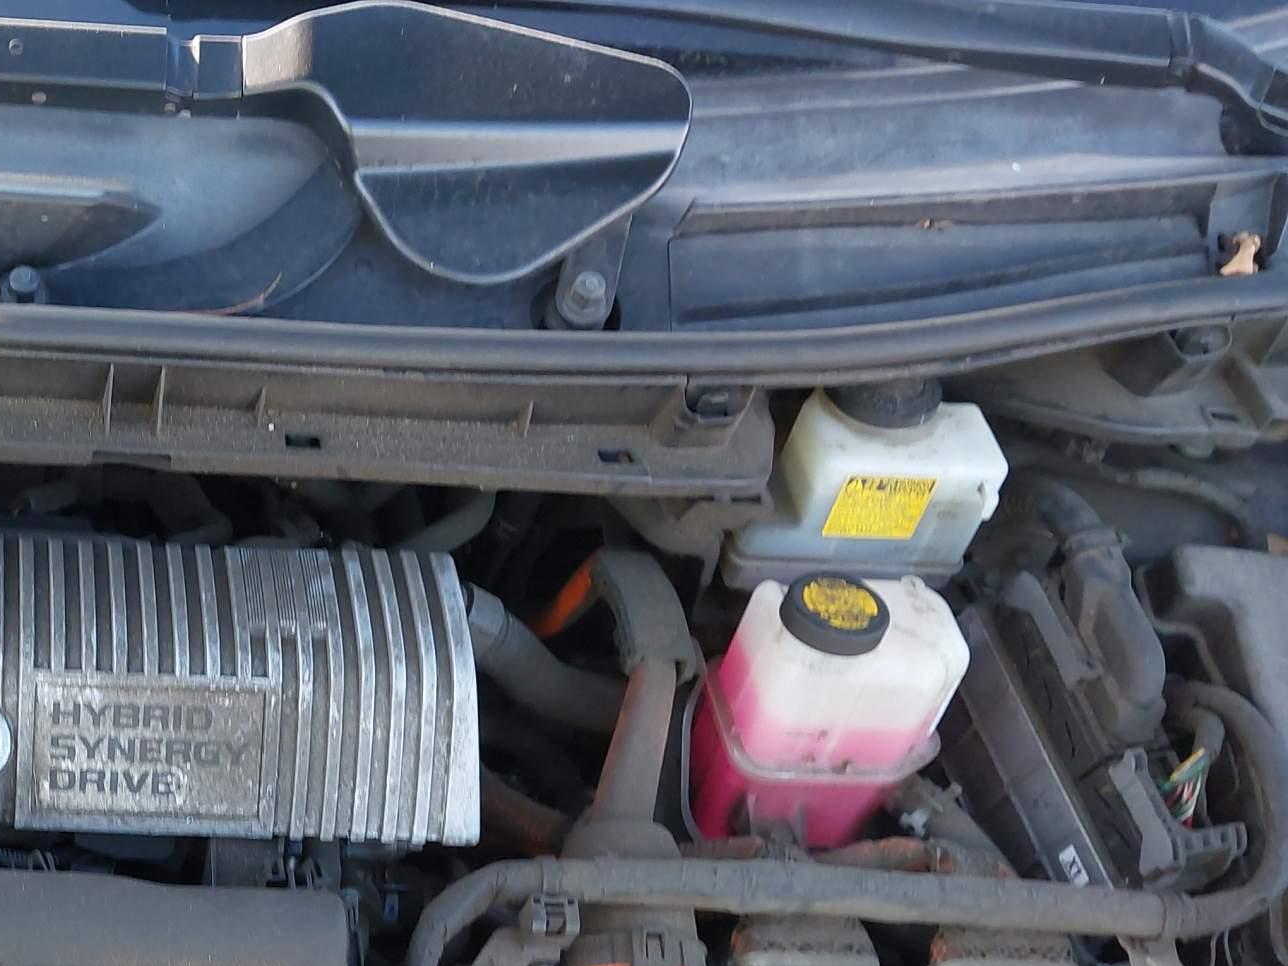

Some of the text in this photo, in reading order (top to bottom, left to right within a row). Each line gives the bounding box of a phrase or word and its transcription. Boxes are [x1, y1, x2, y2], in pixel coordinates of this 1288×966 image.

[52, 701, 213, 730] HYBRID
[50, 735, 249, 766] SYNERGY
[48, 769, 176, 794] DRIVE
